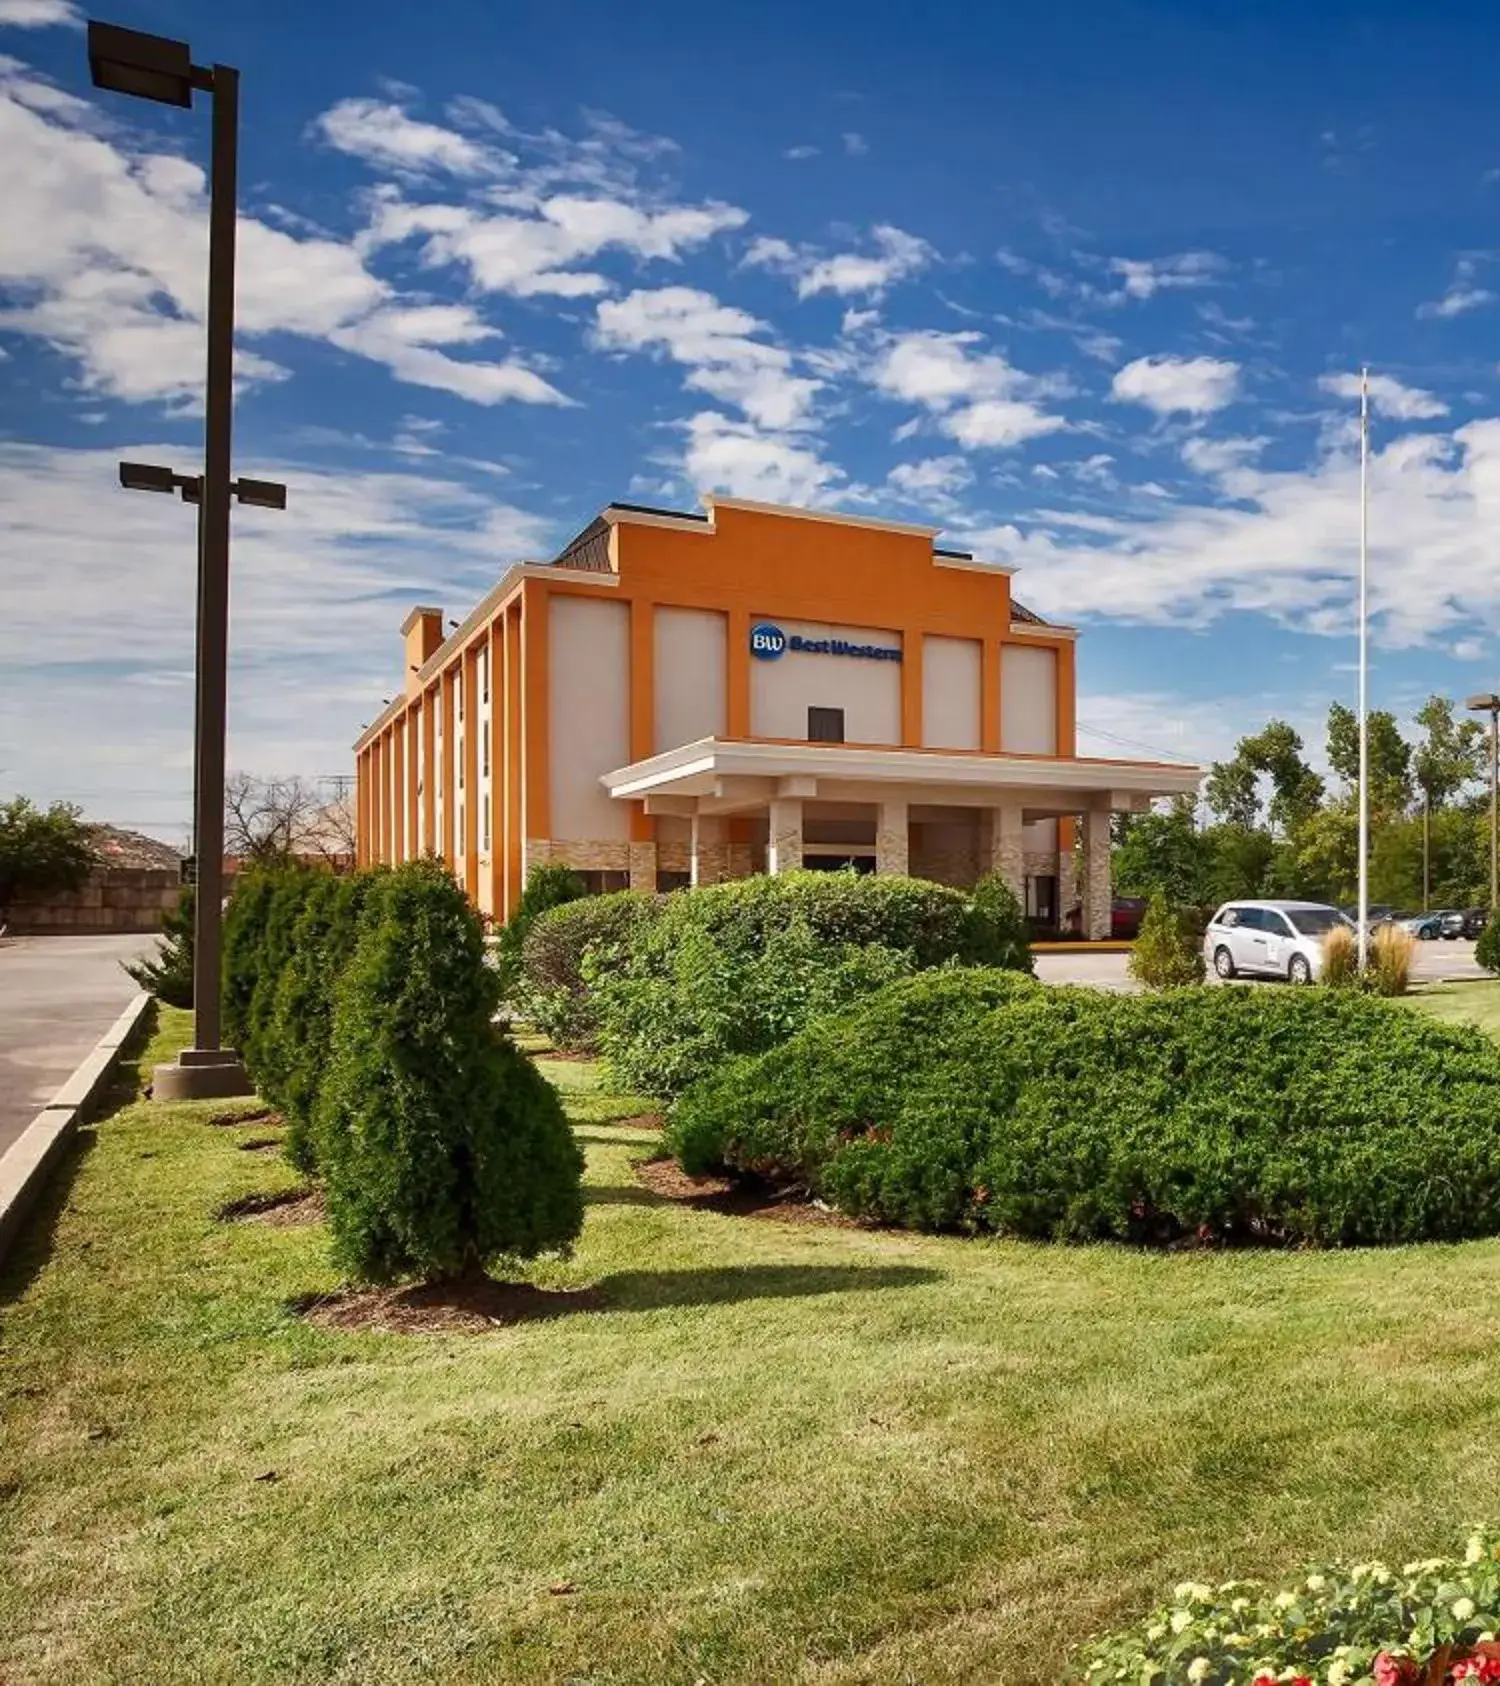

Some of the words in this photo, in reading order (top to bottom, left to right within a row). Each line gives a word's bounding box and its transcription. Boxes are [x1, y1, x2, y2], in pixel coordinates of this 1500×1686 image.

[753, 634, 784, 651] BW
[789, 635, 829, 654] Best
[830, 639, 903, 662] Western
